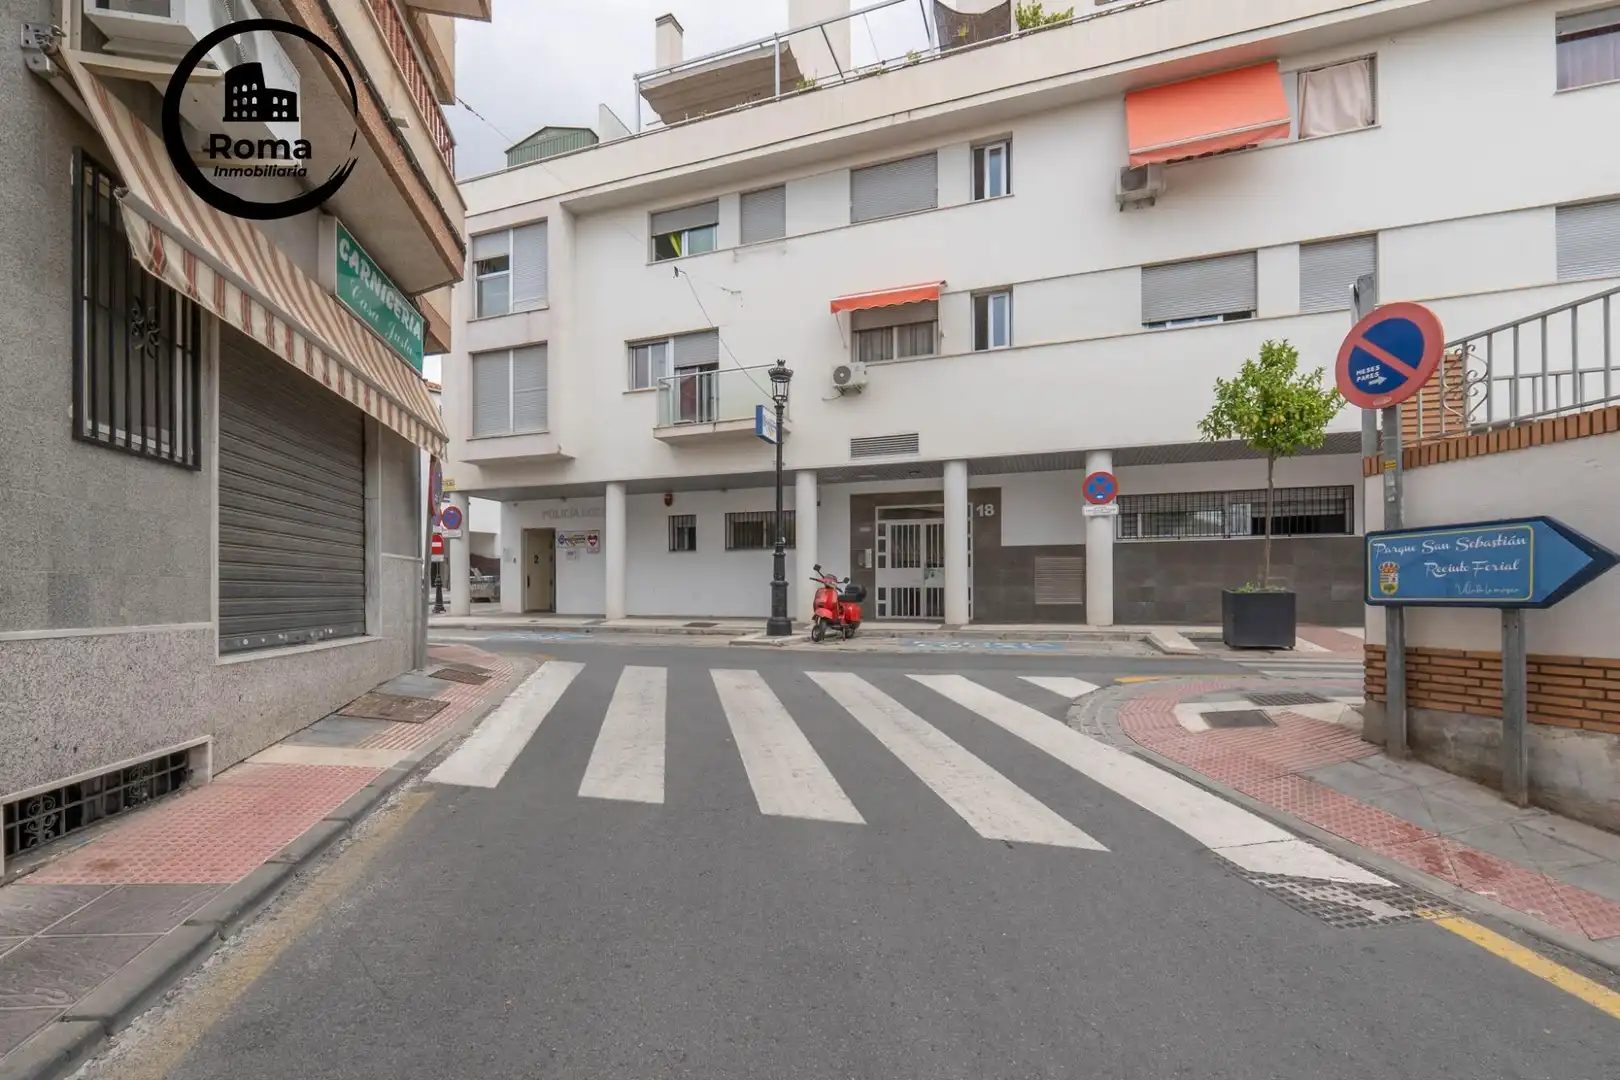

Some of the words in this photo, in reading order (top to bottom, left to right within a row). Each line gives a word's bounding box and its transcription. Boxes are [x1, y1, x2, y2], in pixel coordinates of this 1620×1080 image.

[339, 238, 421, 341] CARNICERIA
[1356, 365, 1380, 376] MESES
[1356, 372, 1380, 382] PARES
[976, 504, 995, 518] 18
[1373, 543, 1416, 558] Parque
[1421, 540, 1450, 554] San
[1456, 535, 1527, 551] Sebastián
[1424, 562, 1469, 578] Recinto
[1472, 560, 1520, 577] Ferial
